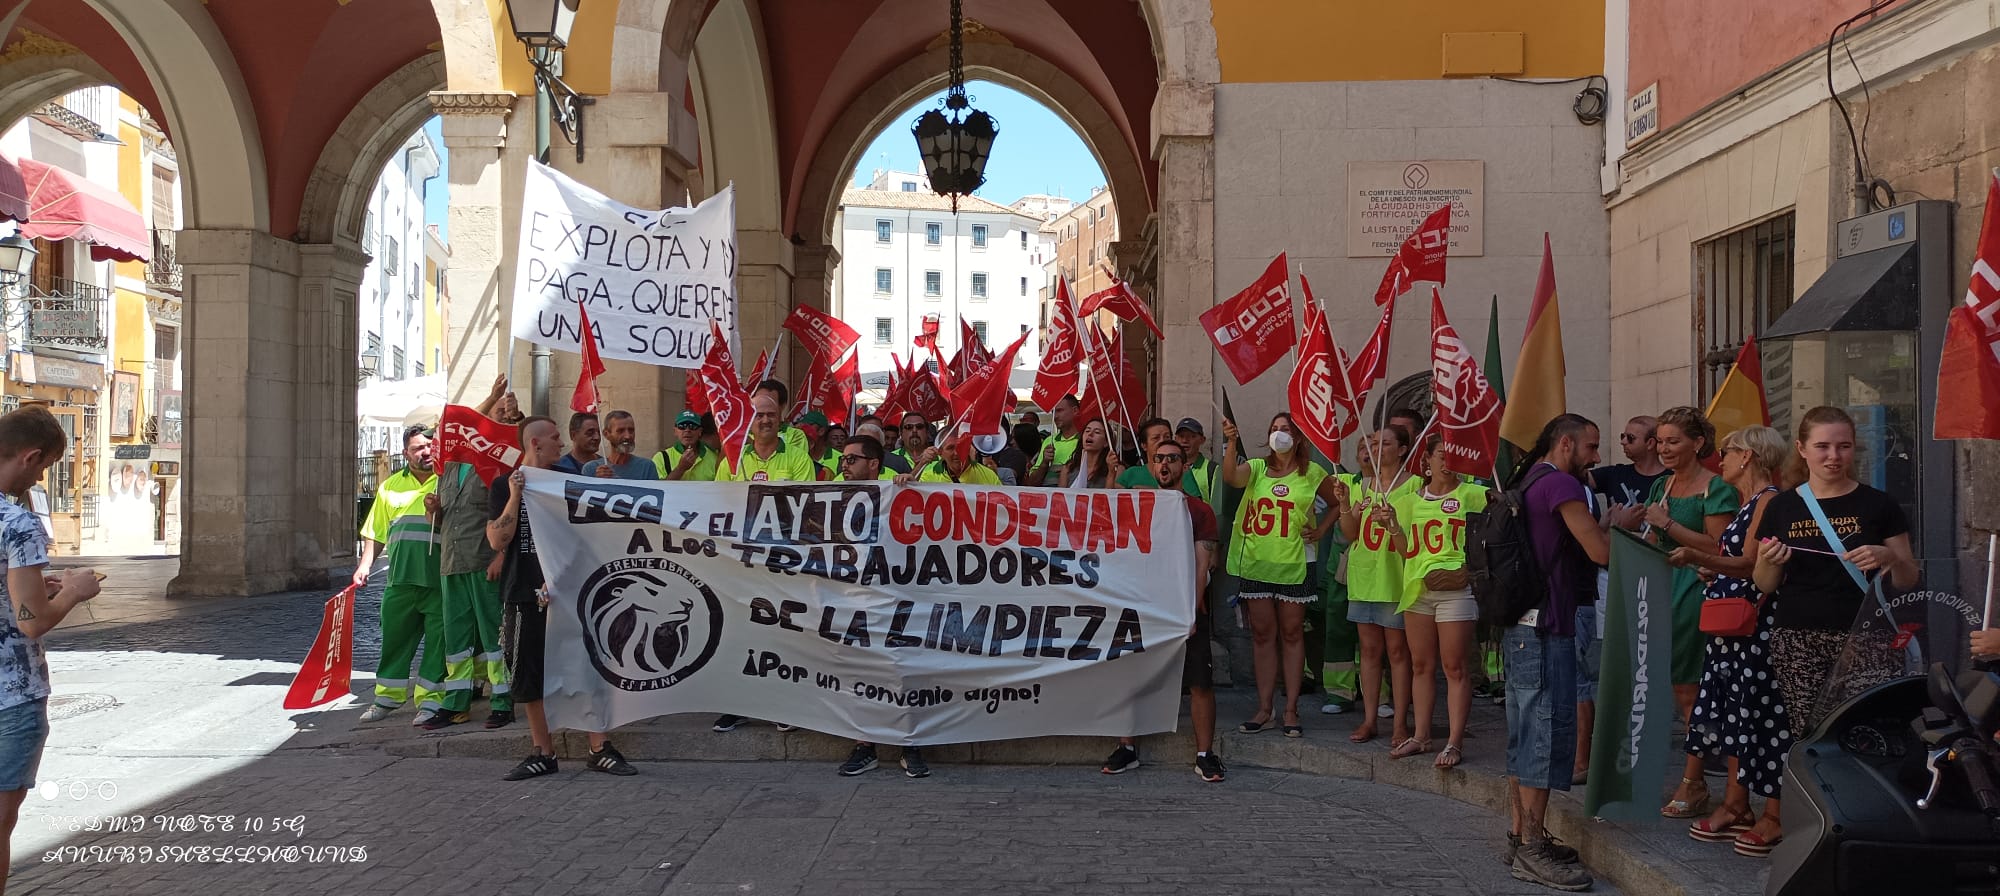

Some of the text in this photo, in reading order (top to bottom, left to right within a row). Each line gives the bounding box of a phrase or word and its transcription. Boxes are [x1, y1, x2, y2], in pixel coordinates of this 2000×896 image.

[1633, 90, 1652, 112] CALLE
[1381, 202, 1415, 210] CIUDAD
[1416, 201, 1464, 210] HISTOCA
[530, 211, 690, 272] EXPLOTA
[699, 235, 712, 270] Y
[1362, 226, 1374, 234] LA
[1374, 226, 1399, 234] LISTA
[538, 311, 605, 349] UNA
[1305, 357, 1333, 425] UGT
[574, 488, 659, 520] FCC
[679, 510, 700, 530] Y
[708, 512, 738, 538] EL
[888, 488, 1156, 554] CONDENAN
[1836, 525, 1862, 535] OVE
[605, 558, 705, 590] FRENTE OBRERO
[626, 528, 653, 555] A
[731, 542, 1101, 589] TRABAJADORES
[749, 597, 1146, 661] DE LA LIMPIEZA
[816, 671, 841, 692] un
[853, 681, 954, 708] convenio
